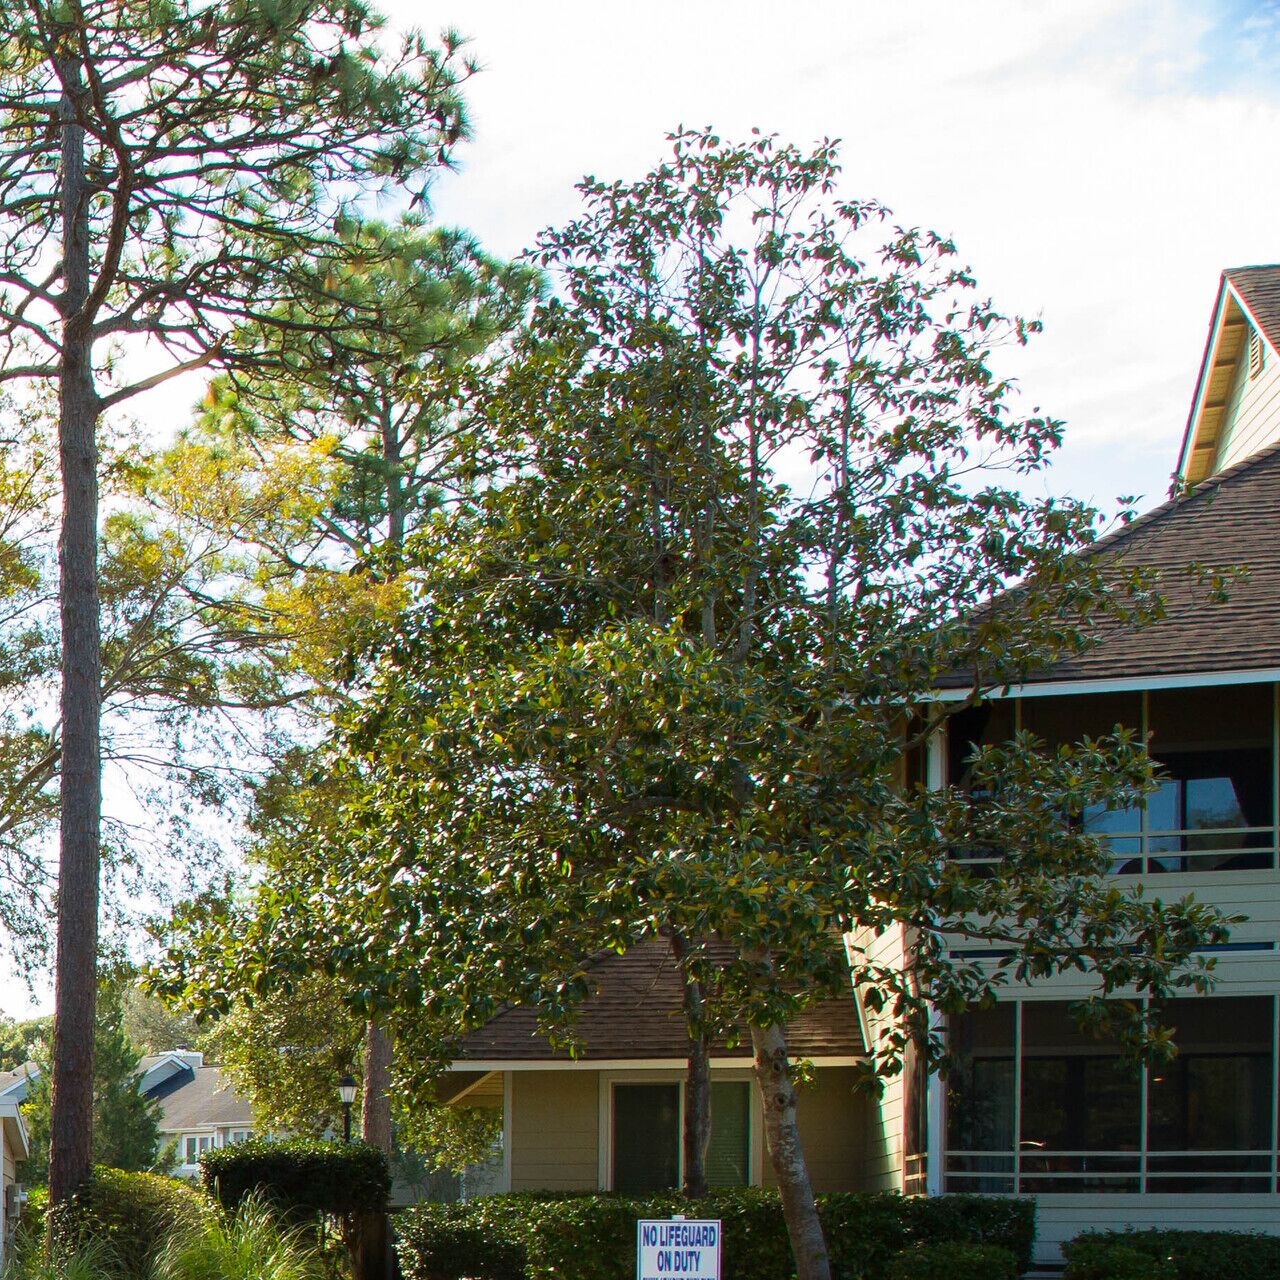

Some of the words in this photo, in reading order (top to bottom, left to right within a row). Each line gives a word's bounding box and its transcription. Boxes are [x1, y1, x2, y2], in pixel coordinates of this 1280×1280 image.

[643, 1226, 657, 1247] NO
[659, 1226, 716, 1247] LIFEGUARD
[657, 1251, 672, 1272] ON
[674, 1251, 700, 1272] DUTY
